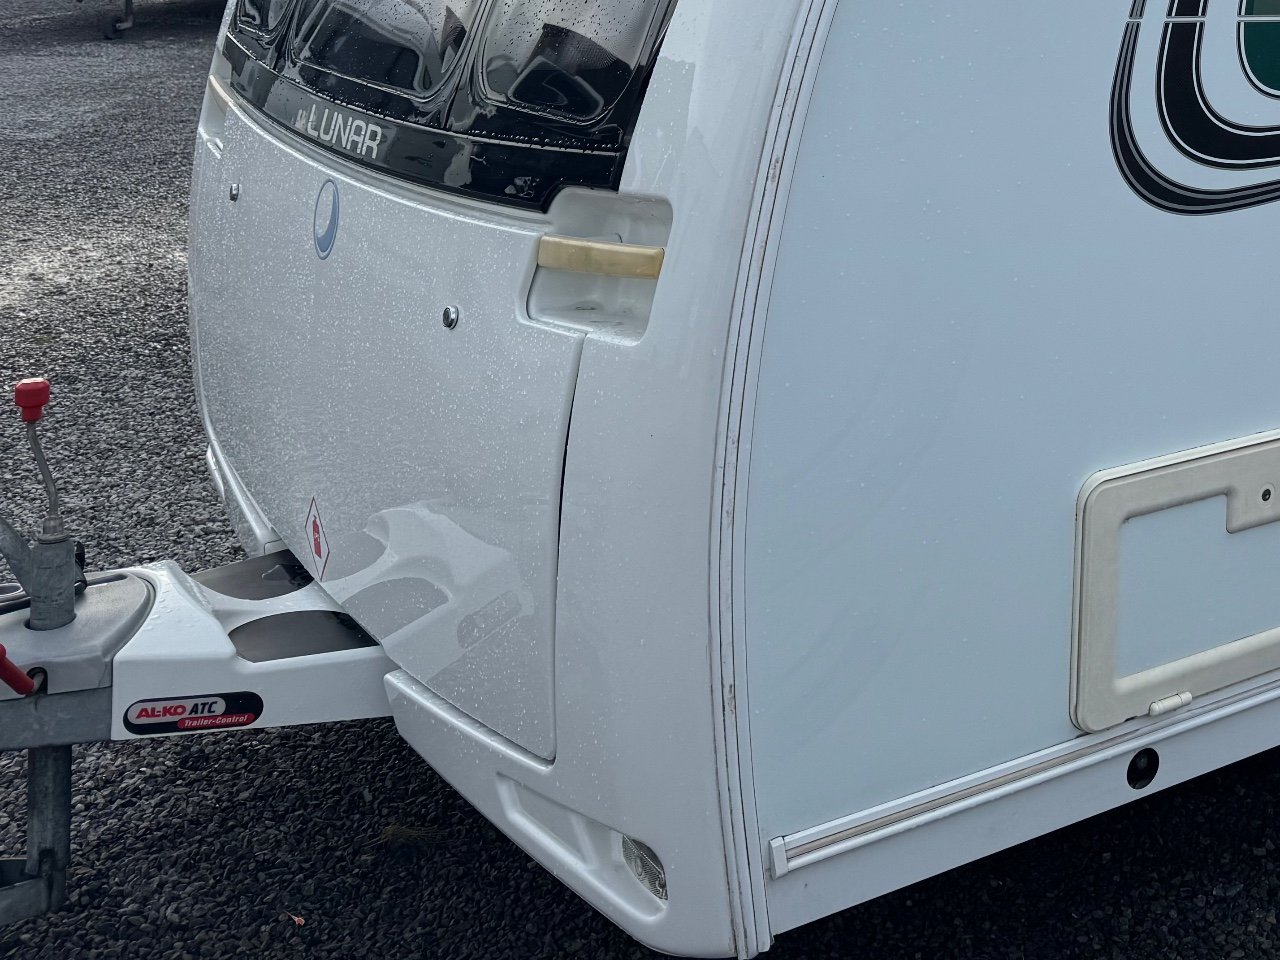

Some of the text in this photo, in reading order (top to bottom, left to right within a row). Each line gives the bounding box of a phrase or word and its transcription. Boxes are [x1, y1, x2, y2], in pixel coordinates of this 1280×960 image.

[307, 103, 382, 159] LUNAR
[135, 701, 218, 720] AL-KO ATC
[184, 714, 248, 727] Trailer-Control
